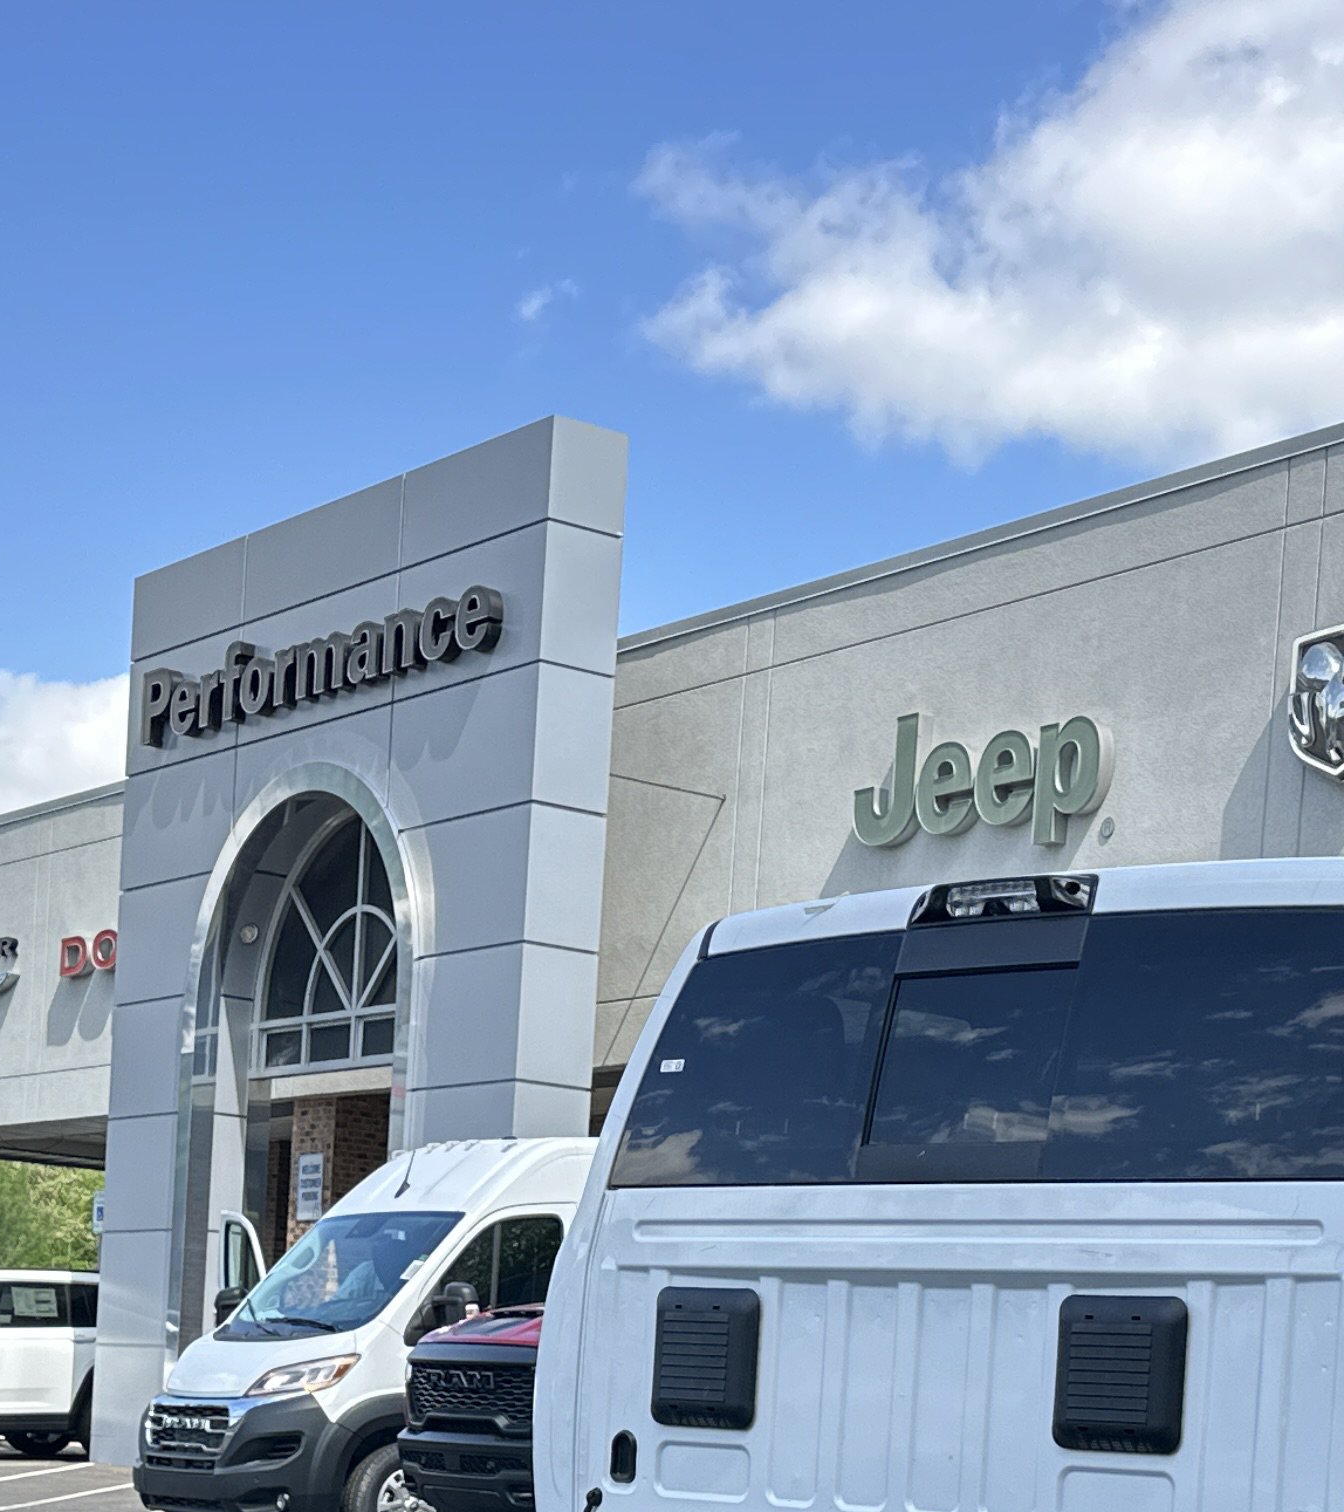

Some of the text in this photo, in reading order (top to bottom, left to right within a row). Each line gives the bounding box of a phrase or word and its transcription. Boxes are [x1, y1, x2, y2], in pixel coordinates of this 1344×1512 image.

[142, 584, 504, 748] Performance
[854, 712, 1115, 848] Jeep
[424, 1368, 494, 1390] RAM
